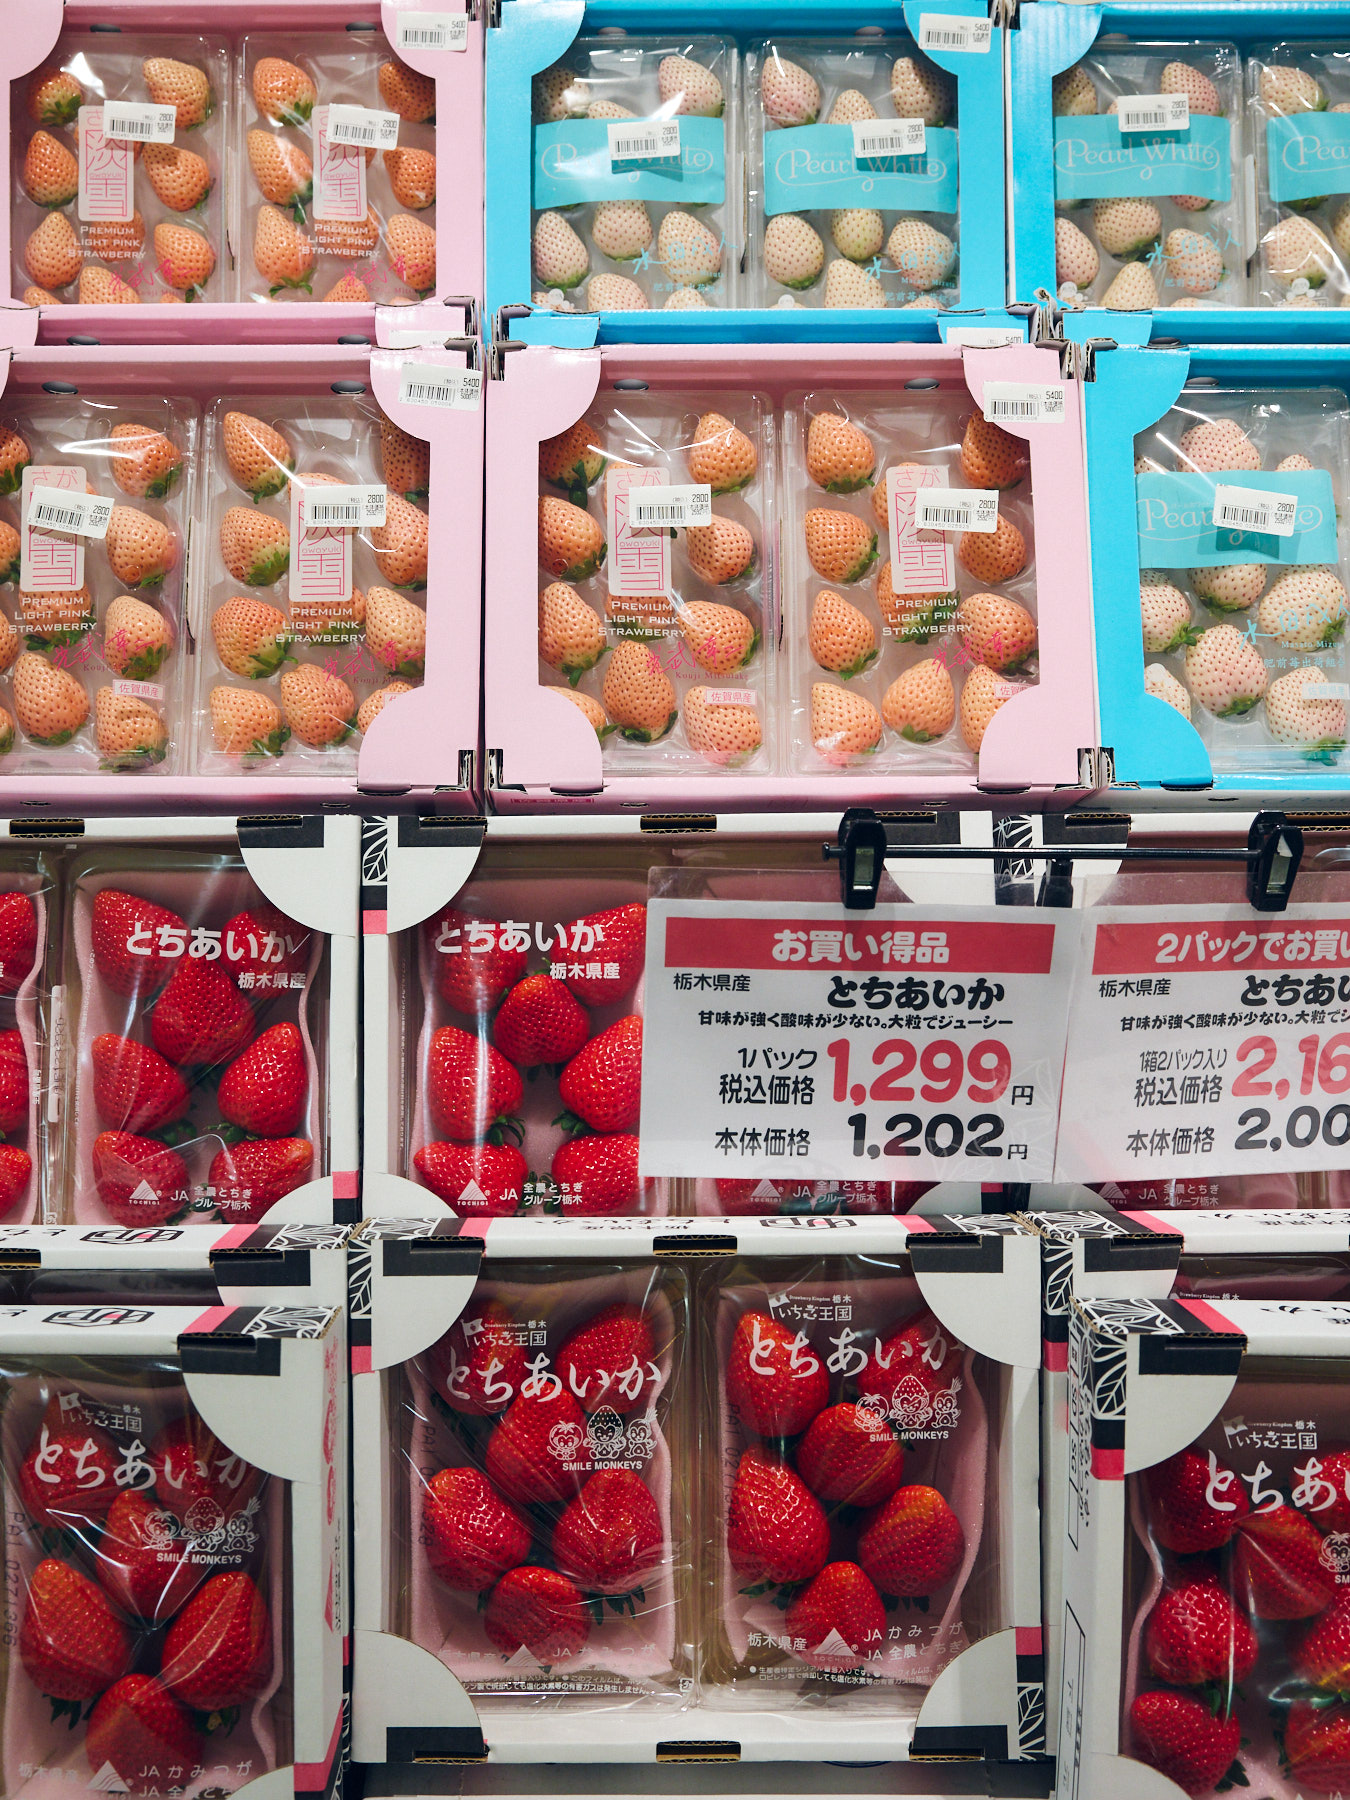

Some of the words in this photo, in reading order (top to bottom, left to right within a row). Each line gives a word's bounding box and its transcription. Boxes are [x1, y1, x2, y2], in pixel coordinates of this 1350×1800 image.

[1053, 138, 1136, 168] Pearl
[1140, 137, 1214, 165] White
[1283, 135, 1350, 166] Pea
[80, 226, 134, 235] PREMIUM
[314, 224, 368, 234] PREMIUM
[113, 239, 140, 247] PINK
[308, 235, 342, 243] LIGHT
[347, 238, 374, 246] PINK
[68, 249, 146, 259] STRAWBERRY
[301, 246, 380, 258] STRAWBERRY
[463, 378, 480, 387] 5400
[1046, 391, 1063, 400] 5400
[616, 470, 661, 491] さが
[895, 468, 941, 488] さが
[367, 494, 384, 504] 2800
[692, 493, 709, 503] 2800
[979, 499, 996, 509] 2800
[93, 505, 110, 516] 2800
[1277, 503, 1294, 513] 2800
[619, 540, 660, 548] awayuki
[22, 597, 84, 607] PREMIUM
[611, 601, 673, 611] PREMIUM
[895, 598, 958, 608] PREMIUM
[14, 611, 53, 620] LIGHT
[59, 609, 91, 618] PINK
[291, 607, 353, 616] PREMIUM
[888, 612, 929, 623] LIGHT
[934, 611, 965, 620] PINK
[282, 621, 323, 629] LIGHT
[328, 621, 360, 629] PINK
[604, 614, 643, 623] LIGHT
[649, 616, 680, 625] PINK
[8, 622, 98, 634] STRAWBERRY
[598, 627, 687, 637] STRAWBERRY
[882, 624, 972, 636] STRAWBERRY
[275, 634, 367, 643] STRAWBERRY
[119, 683, 160, 698] 佐賀県産
[711, 692, 752, 703] 佐賀県産
[127, 922, 295, 963] とちあいか
[434, 919, 602, 954] とちあいか
[771, 929, 950, 964] お買い得品
[550, 962, 620, 979] 栃木県産
[238, 972, 306, 989] 栃木県産
[673, 972, 751, 992] 栃木県産
[827, 975, 1005, 1011] とちあいか
[1099, 978, 1172, 998] 栃木県産
[698, 1009, 1014, 1030] 甘味が強く酸味が少ない。大粒でジューシー
[738, 1047, 818, 1070] 1パック
[1139, 1048, 1227, 1073] 1箱2パック入り
[719, 1074, 815, 1106] 税込価格
[826, 1038, 1012, 1106] 1,299
[1011, 1085, 1034, 1106] 円
[1134, 1074, 1223, 1108] 税込価格
[1231, 1032, 1350, 1101] 2,16
[714, 1128, 811, 1157] 本体価格
[848, 1113, 1004, 1159] 1,202
[1007, 1143, 1028, 1160] 円
[1126, 1126, 1215, 1158] 本体価格
[1234, 1103, 1350, 1152] 2,00
[499, 1188, 519, 1200] JA
[523, 1182, 583, 1193] 全農とちぎ
[792, 1186, 812, 1198] JA
[816, 1180, 877, 1192] 全農とちぎ
[1138, 1188, 1158, 1200] JA
[170, 1190, 190, 1201] JA
[524, 1194, 583, 1206] グループ栃木
[818, 1193, 877, 1203] グループ栃木
[832, 1295, 852, 1304] 栃木
[778, 1304, 852, 1321] いちご王国
[528, 1320, 547, 1329] 栃木
[474, 1331, 547, 1346] いちご王国
[749, 1319, 965, 1378] とちあいか
[446, 1346, 662, 1403] とちあいか
[69, 1409, 142, 1433] いちご王国
[1295, 1420, 1317, 1430] 栃木
[869, 1432, 898, 1442] SMILE
[901, 1431, 949, 1441] MONKEYS
[1236, 1430, 1318, 1450] いちご王国
[562, 1461, 592, 1471] SMILE
[595, 1460, 643, 1470] MONKEYS
[1205, 1449, 1350, 1513] とちあ
[156, 1552, 189, 1563] SMILE
[191, 1553, 242, 1564] MONKEYS
[863, 1629, 883, 1642] JA
[888, 1621, 963, 1640] かみつが
[748, 1632, 807, 1651] 栃木県産
[553, 1647, 571, 1657] JA
[864, 1650, 883, 1662] JA
[889, 1640, 963, 1662] 全農とちぎ
[139, 1765, 161, 1778] JA
[168, 1759, 252, 1779] かみつが
[139, 1785, 160, 1799] JA
